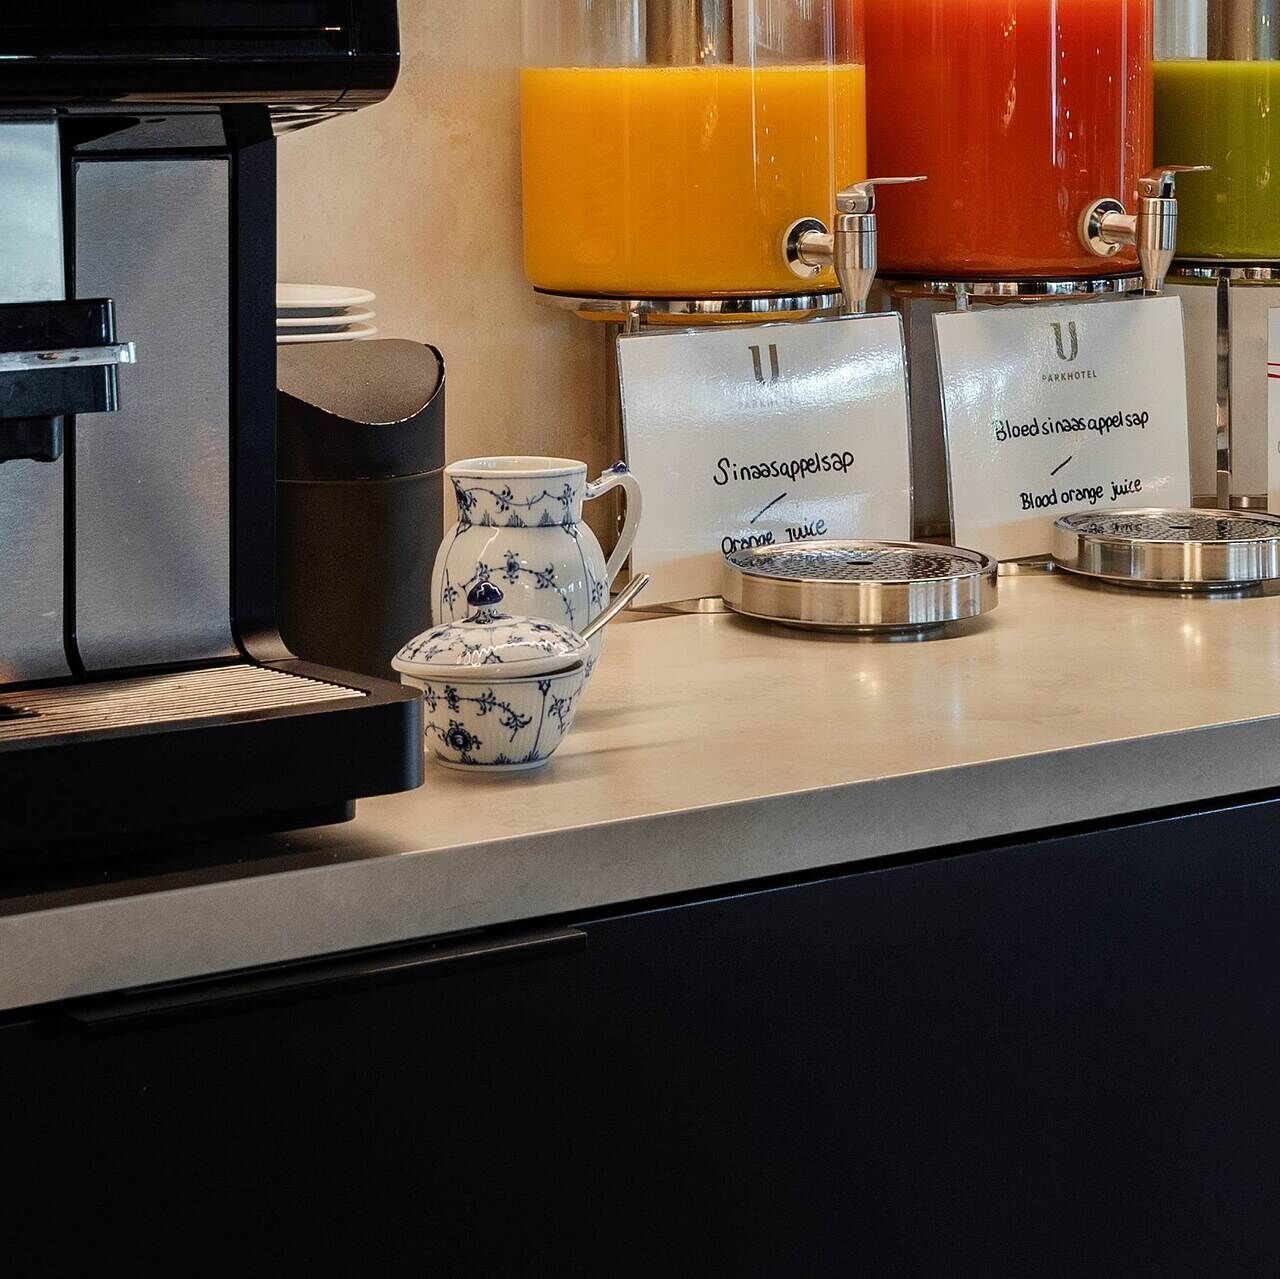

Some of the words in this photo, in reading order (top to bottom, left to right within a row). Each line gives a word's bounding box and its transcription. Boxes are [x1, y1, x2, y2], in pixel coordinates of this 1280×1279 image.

[1042, 370, 1097, 382] PARKHOTEL
[713, 451, 855, 486] Sinaasappelsap
[1019, 488, 1058, 510] Blood
[1060, 485, 1104, 505] orange
[1110, 479, 1144, 501] juice
